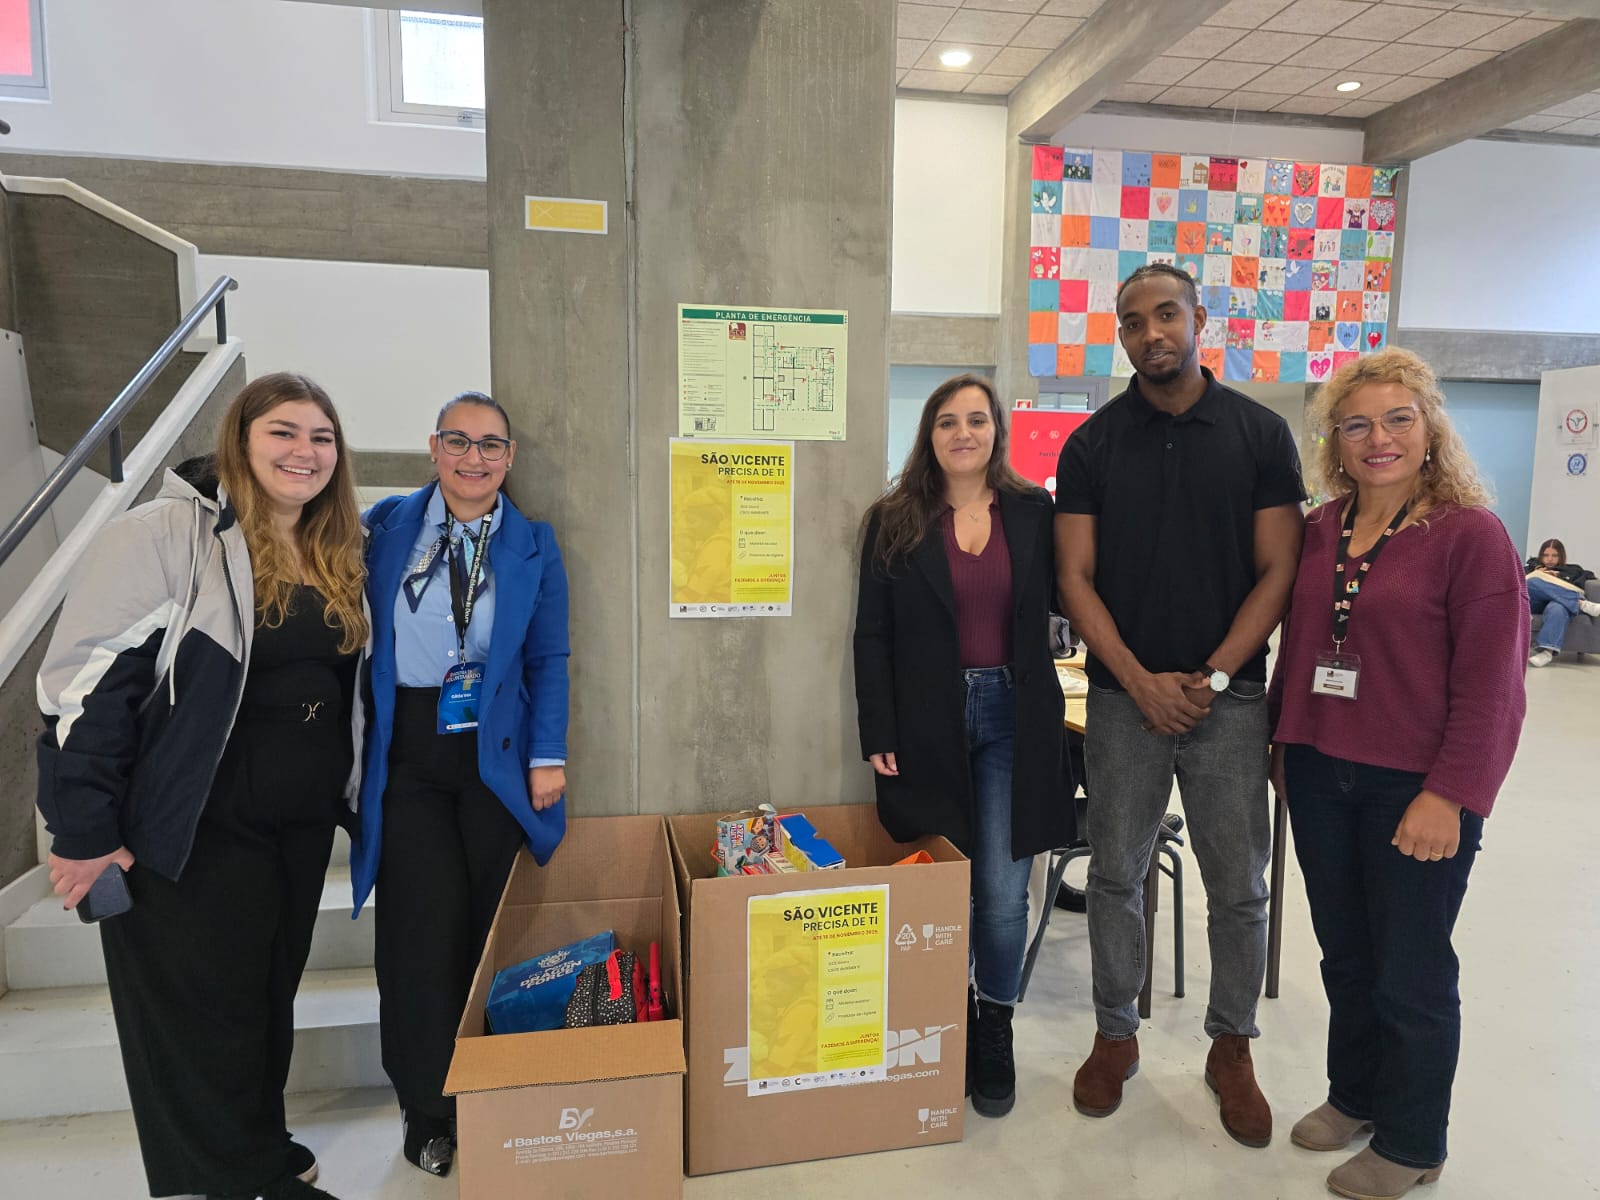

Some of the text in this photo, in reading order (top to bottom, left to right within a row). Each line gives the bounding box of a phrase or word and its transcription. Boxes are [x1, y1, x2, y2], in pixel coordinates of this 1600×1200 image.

[715, 311, 812, 322] PLANTA DE EMERGÊNCIA
[701, 451, 785, 466] SÃO VICENTE
[718, 467, 785, 477] PRECISA DE TI
[783, 902, 878, 921] SÃO VICENTE
[803, 916, 878, 932] PRECISA DE TI
[935, 925, 963, 933] HANDLE
[935, 938, 953, 946] CARE
[520, 960, 582, 987] DRAGON
[526, 968, 574, 989] FORCE
[930, 1107, 958, 1116] HANDLE
[515, 1135, 562, 1147] Bastos
